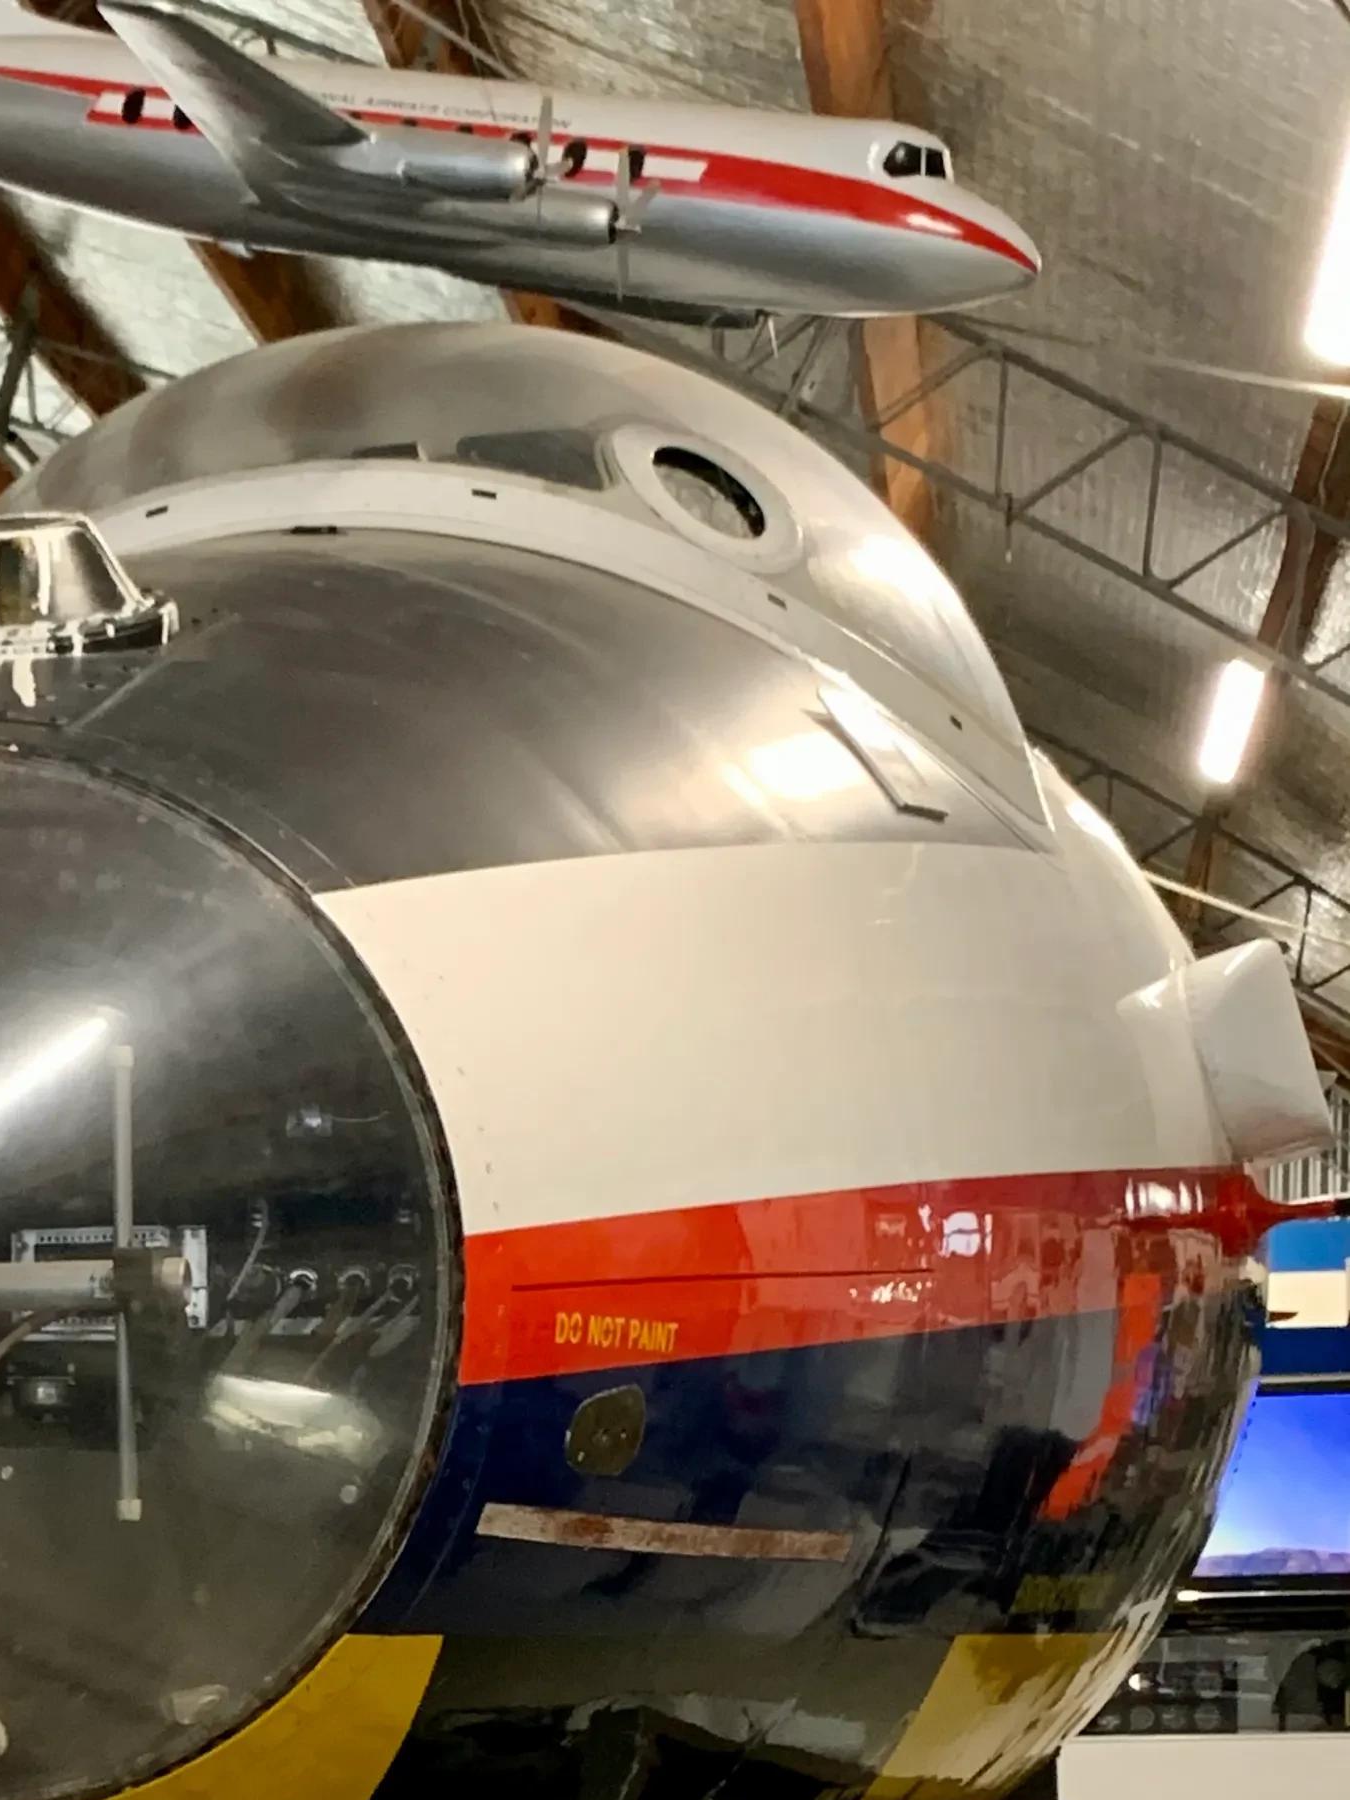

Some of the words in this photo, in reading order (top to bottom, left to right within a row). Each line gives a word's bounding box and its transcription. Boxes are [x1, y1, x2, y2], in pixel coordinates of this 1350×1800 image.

[554, 1311, 583, 1345] DO
[586, 1314, 626, 1348] NOT
[628, 1318, 680, 1353] PAINT
